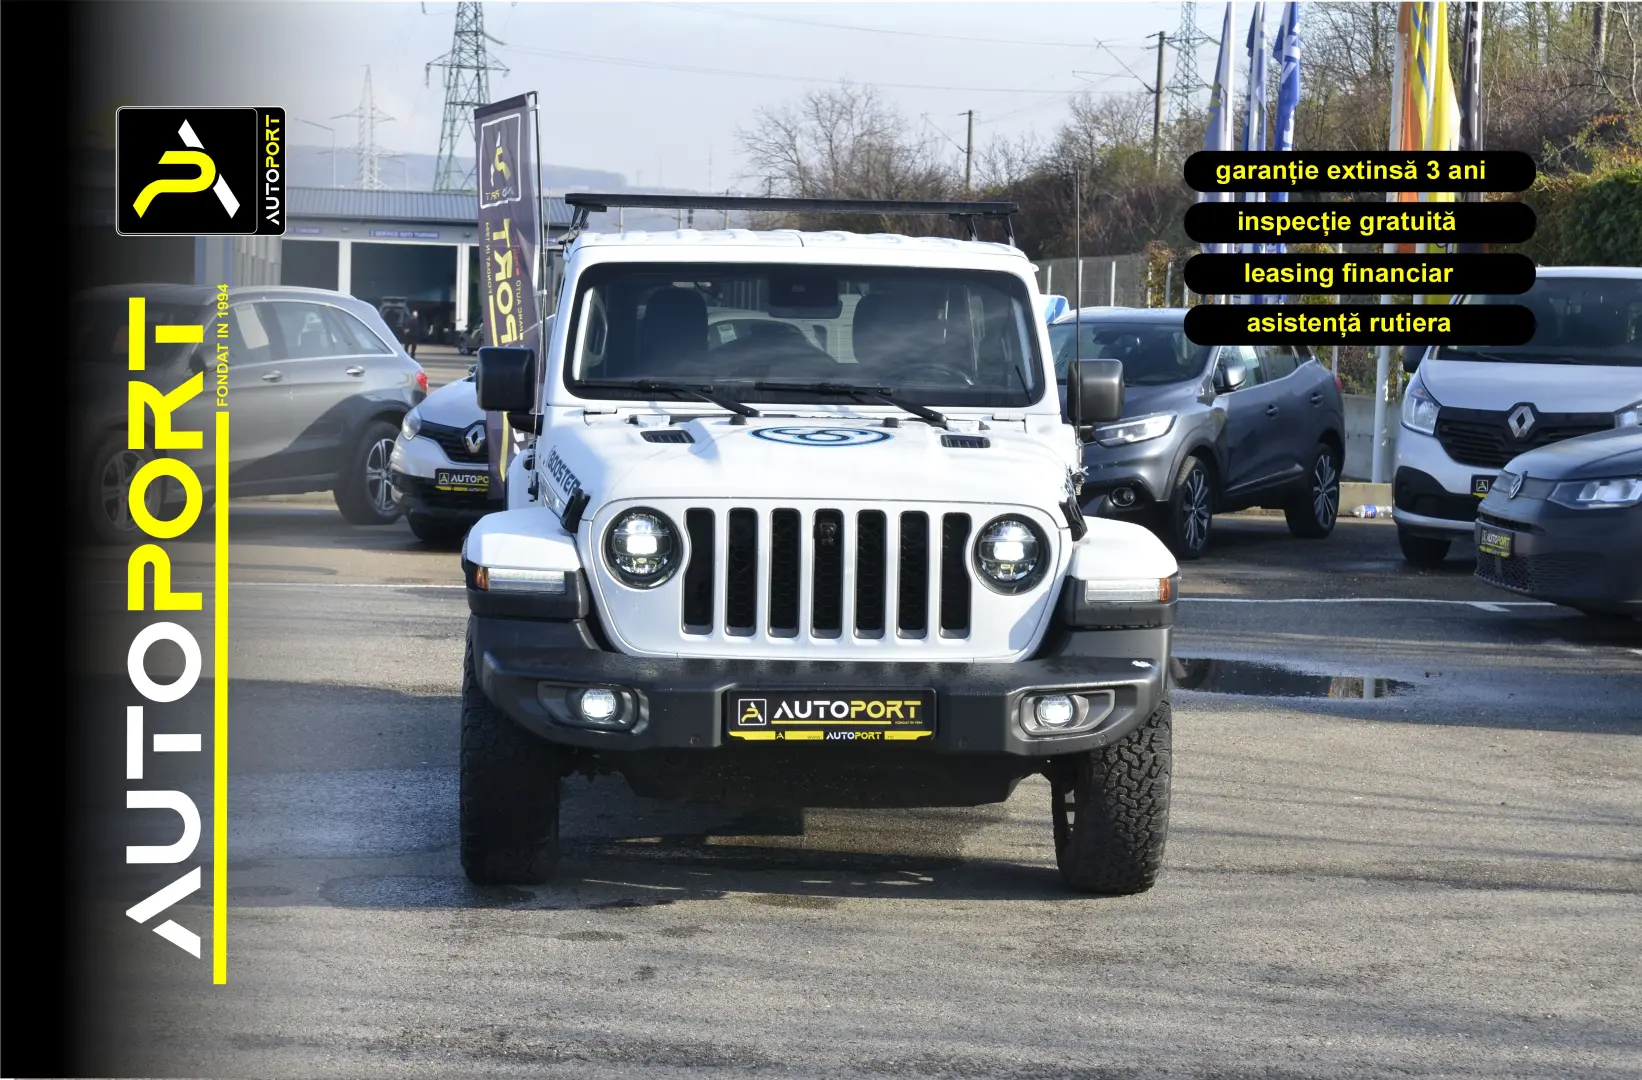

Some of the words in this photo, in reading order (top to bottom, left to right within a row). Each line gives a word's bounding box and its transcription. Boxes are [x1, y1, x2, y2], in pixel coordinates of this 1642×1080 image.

[450, 474, 489, 484] AUTOPO
[773, 700, 922, 719] AUTOPORT
[826, 731, 882, 740] AUTOPORT
